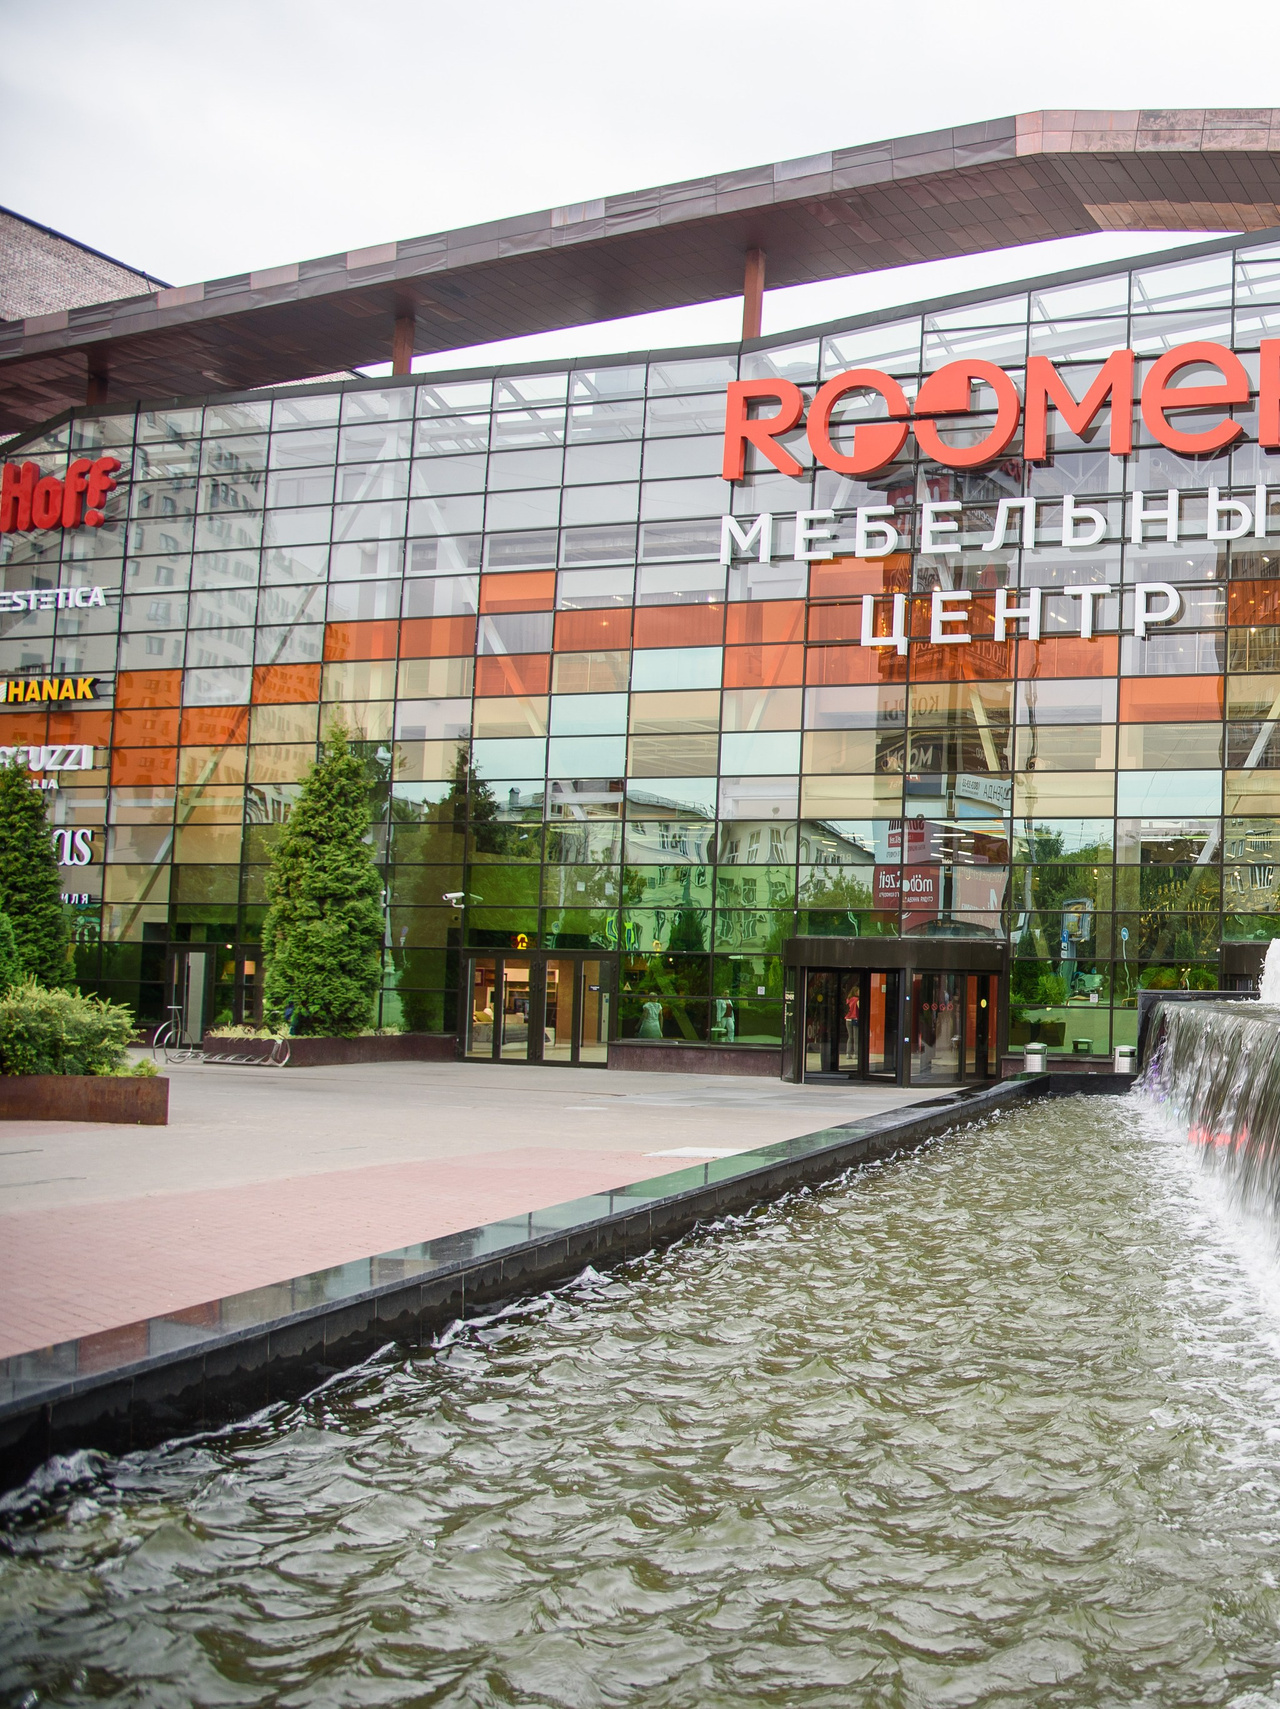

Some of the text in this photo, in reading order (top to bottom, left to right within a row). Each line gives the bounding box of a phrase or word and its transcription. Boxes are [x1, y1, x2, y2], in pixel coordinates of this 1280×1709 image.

[860, 581, 1182, 656] ЦЕНТР
[7, 677, 95, 703] HANAK
[61, 893, 89, 904] ИЛЯ
